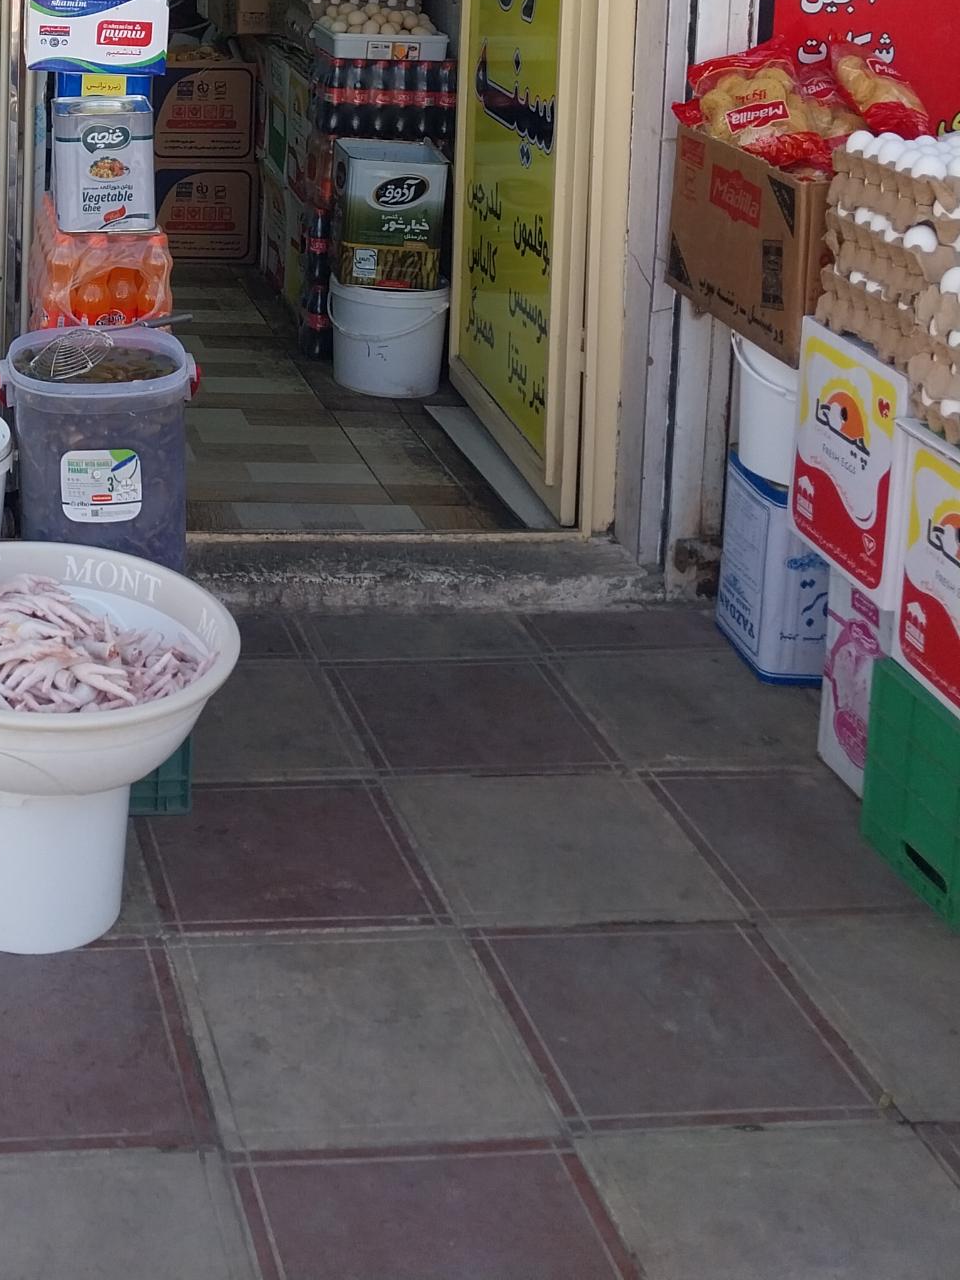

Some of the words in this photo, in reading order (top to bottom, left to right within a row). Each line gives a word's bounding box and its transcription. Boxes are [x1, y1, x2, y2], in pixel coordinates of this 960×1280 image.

[50, 0, 87, 8] shamim
[730, 104, 783, 125] Madilla
[82, 191, 134, 205] Vegetable
[82, 203, 101, 212] Ghee
[65, 555, 162, 603] MONT
